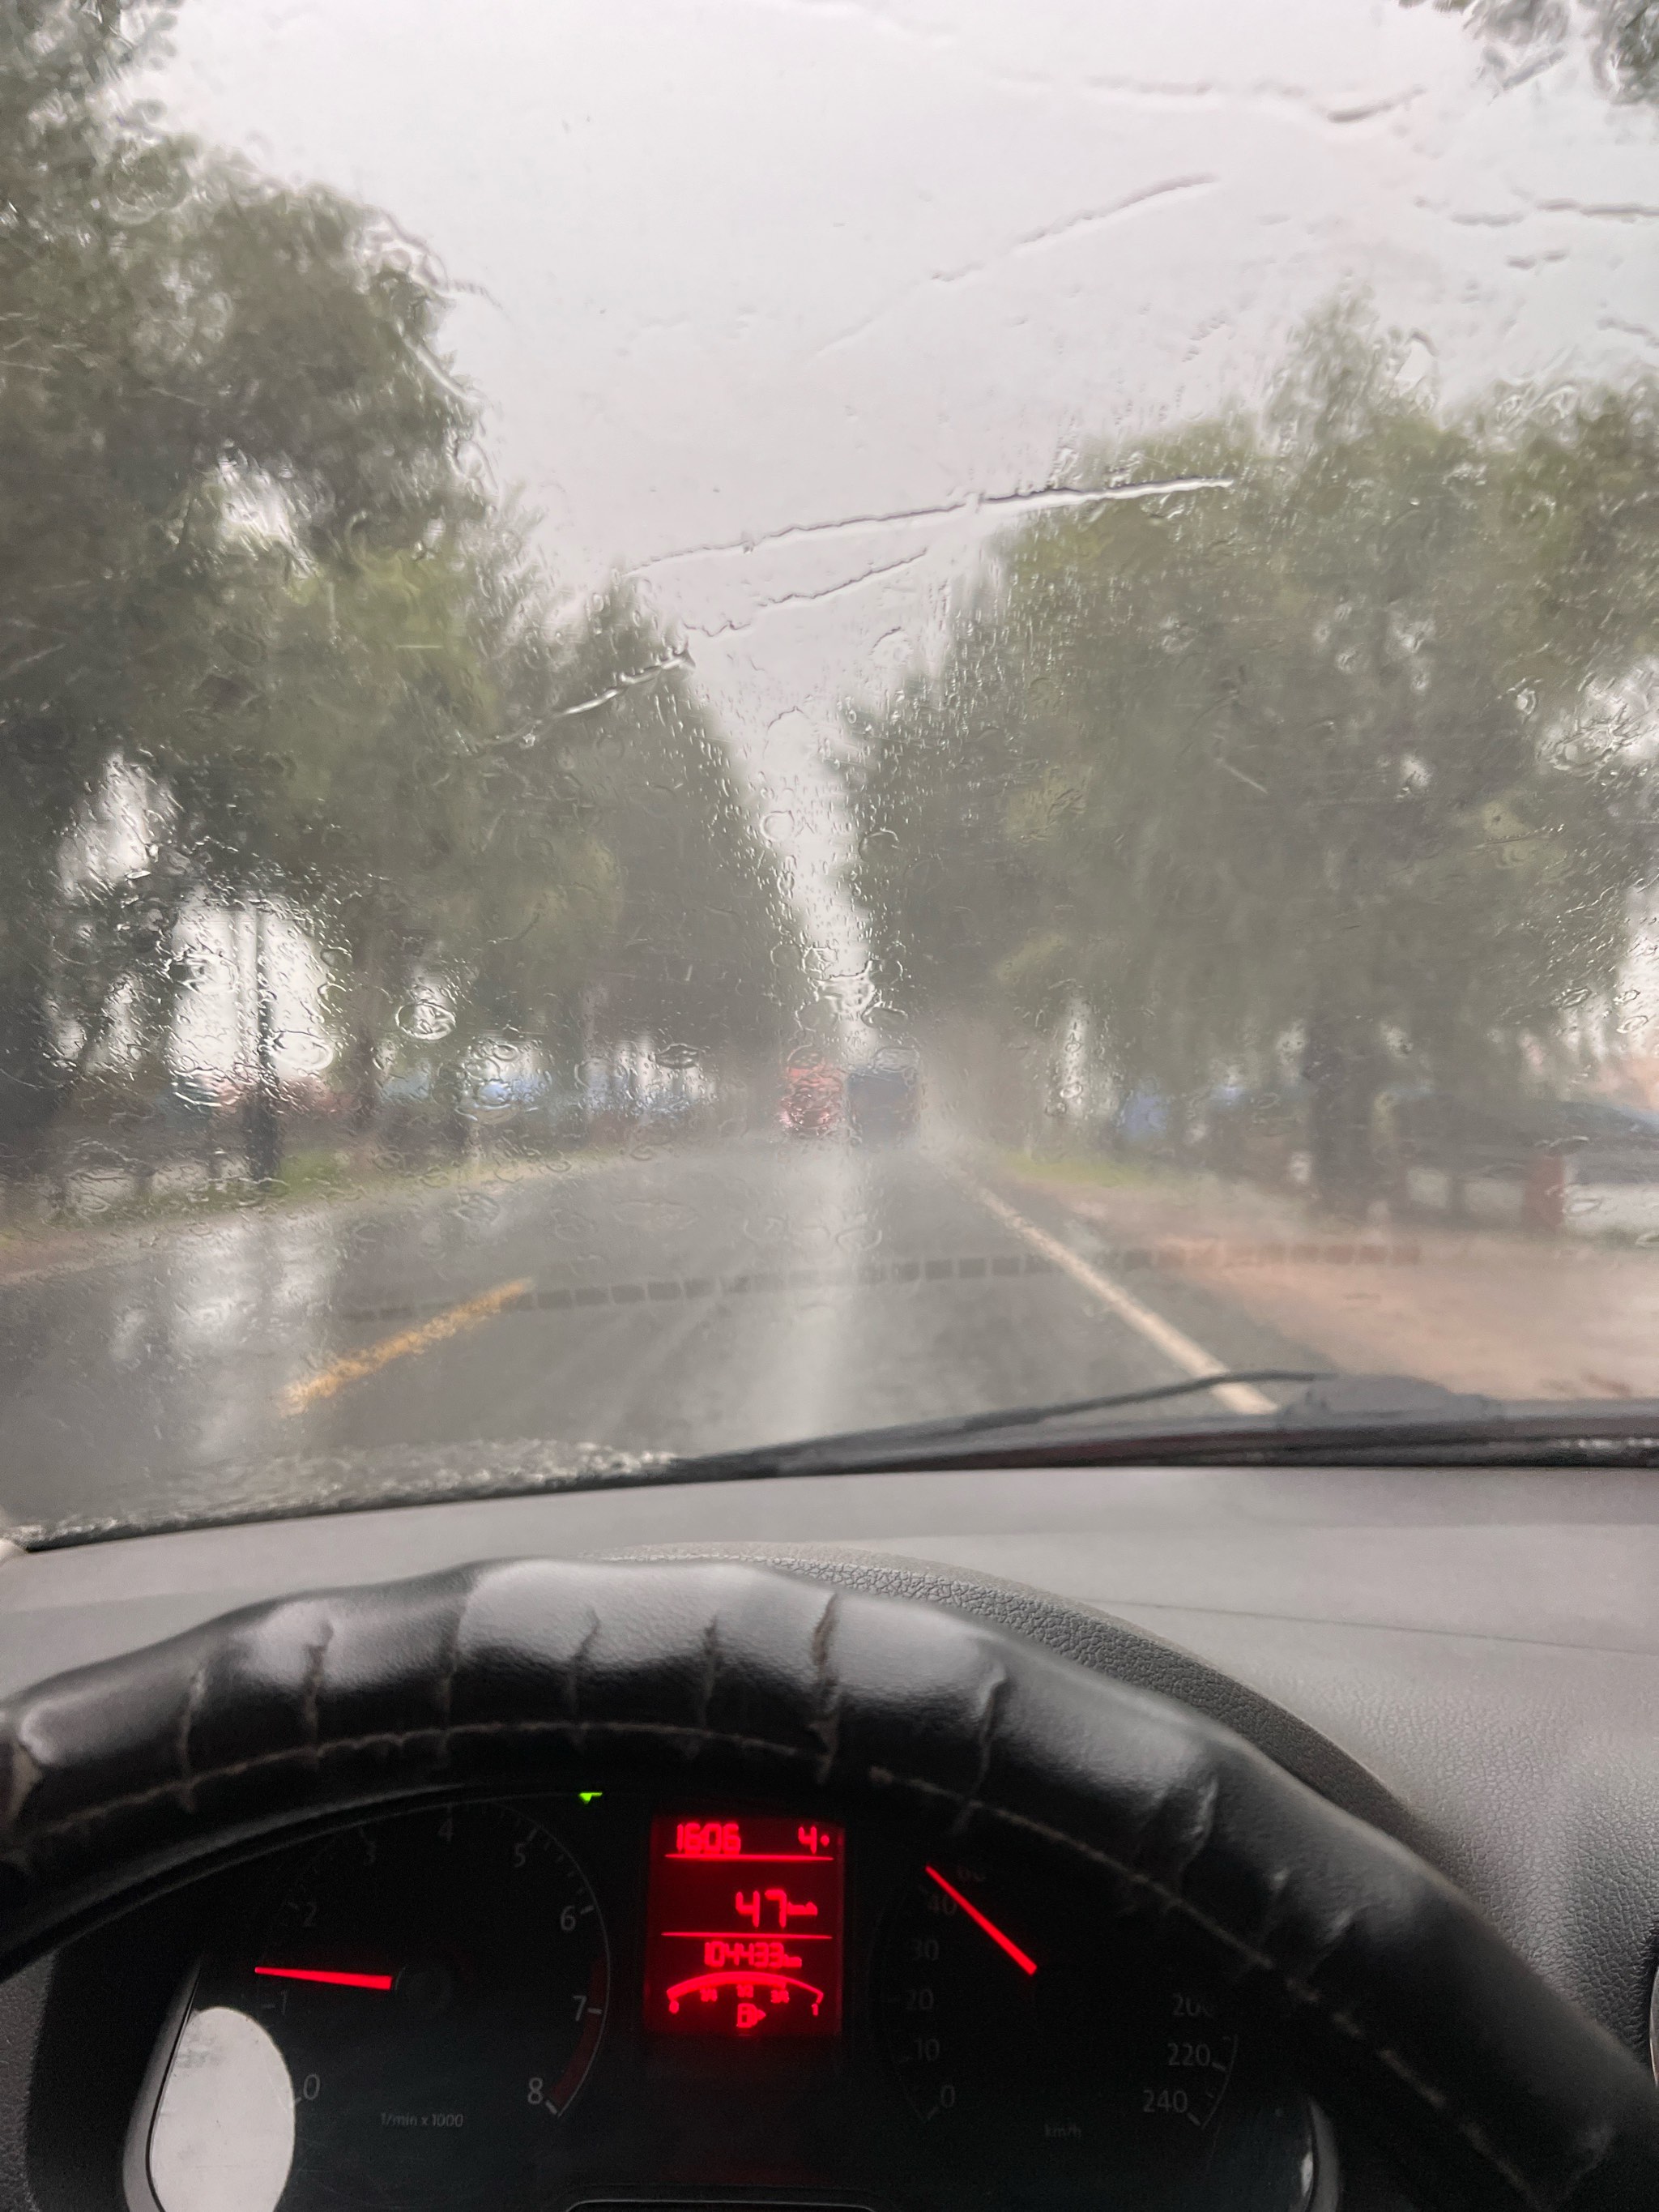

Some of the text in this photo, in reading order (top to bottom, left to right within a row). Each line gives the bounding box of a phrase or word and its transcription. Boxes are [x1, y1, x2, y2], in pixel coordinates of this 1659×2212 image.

[437, 1818, 454, 1842] 4
[364, 1841, 377, 1864] 3
[513, 1842, 527, 1868] 5
[302, 1902, 318, 1927] 2
[560, 1906, 577, 1932] 6
[280, 1990, 289, 2015] 1
[572, 1994, 586, 2022] 7
[915, 2038, 940, 2061] 10
[1167, 2043, 1211, 2067] 220
[302, 2073, 321, 2100] 0
[527, 2077, 544, 2104] 8
[940, 2084, 956, 2108] 0
[1142, 2089, 1188, 2113] 240
[420, 2116, 429, 2126] x
[432, 2112, 464, 2128] 1000
